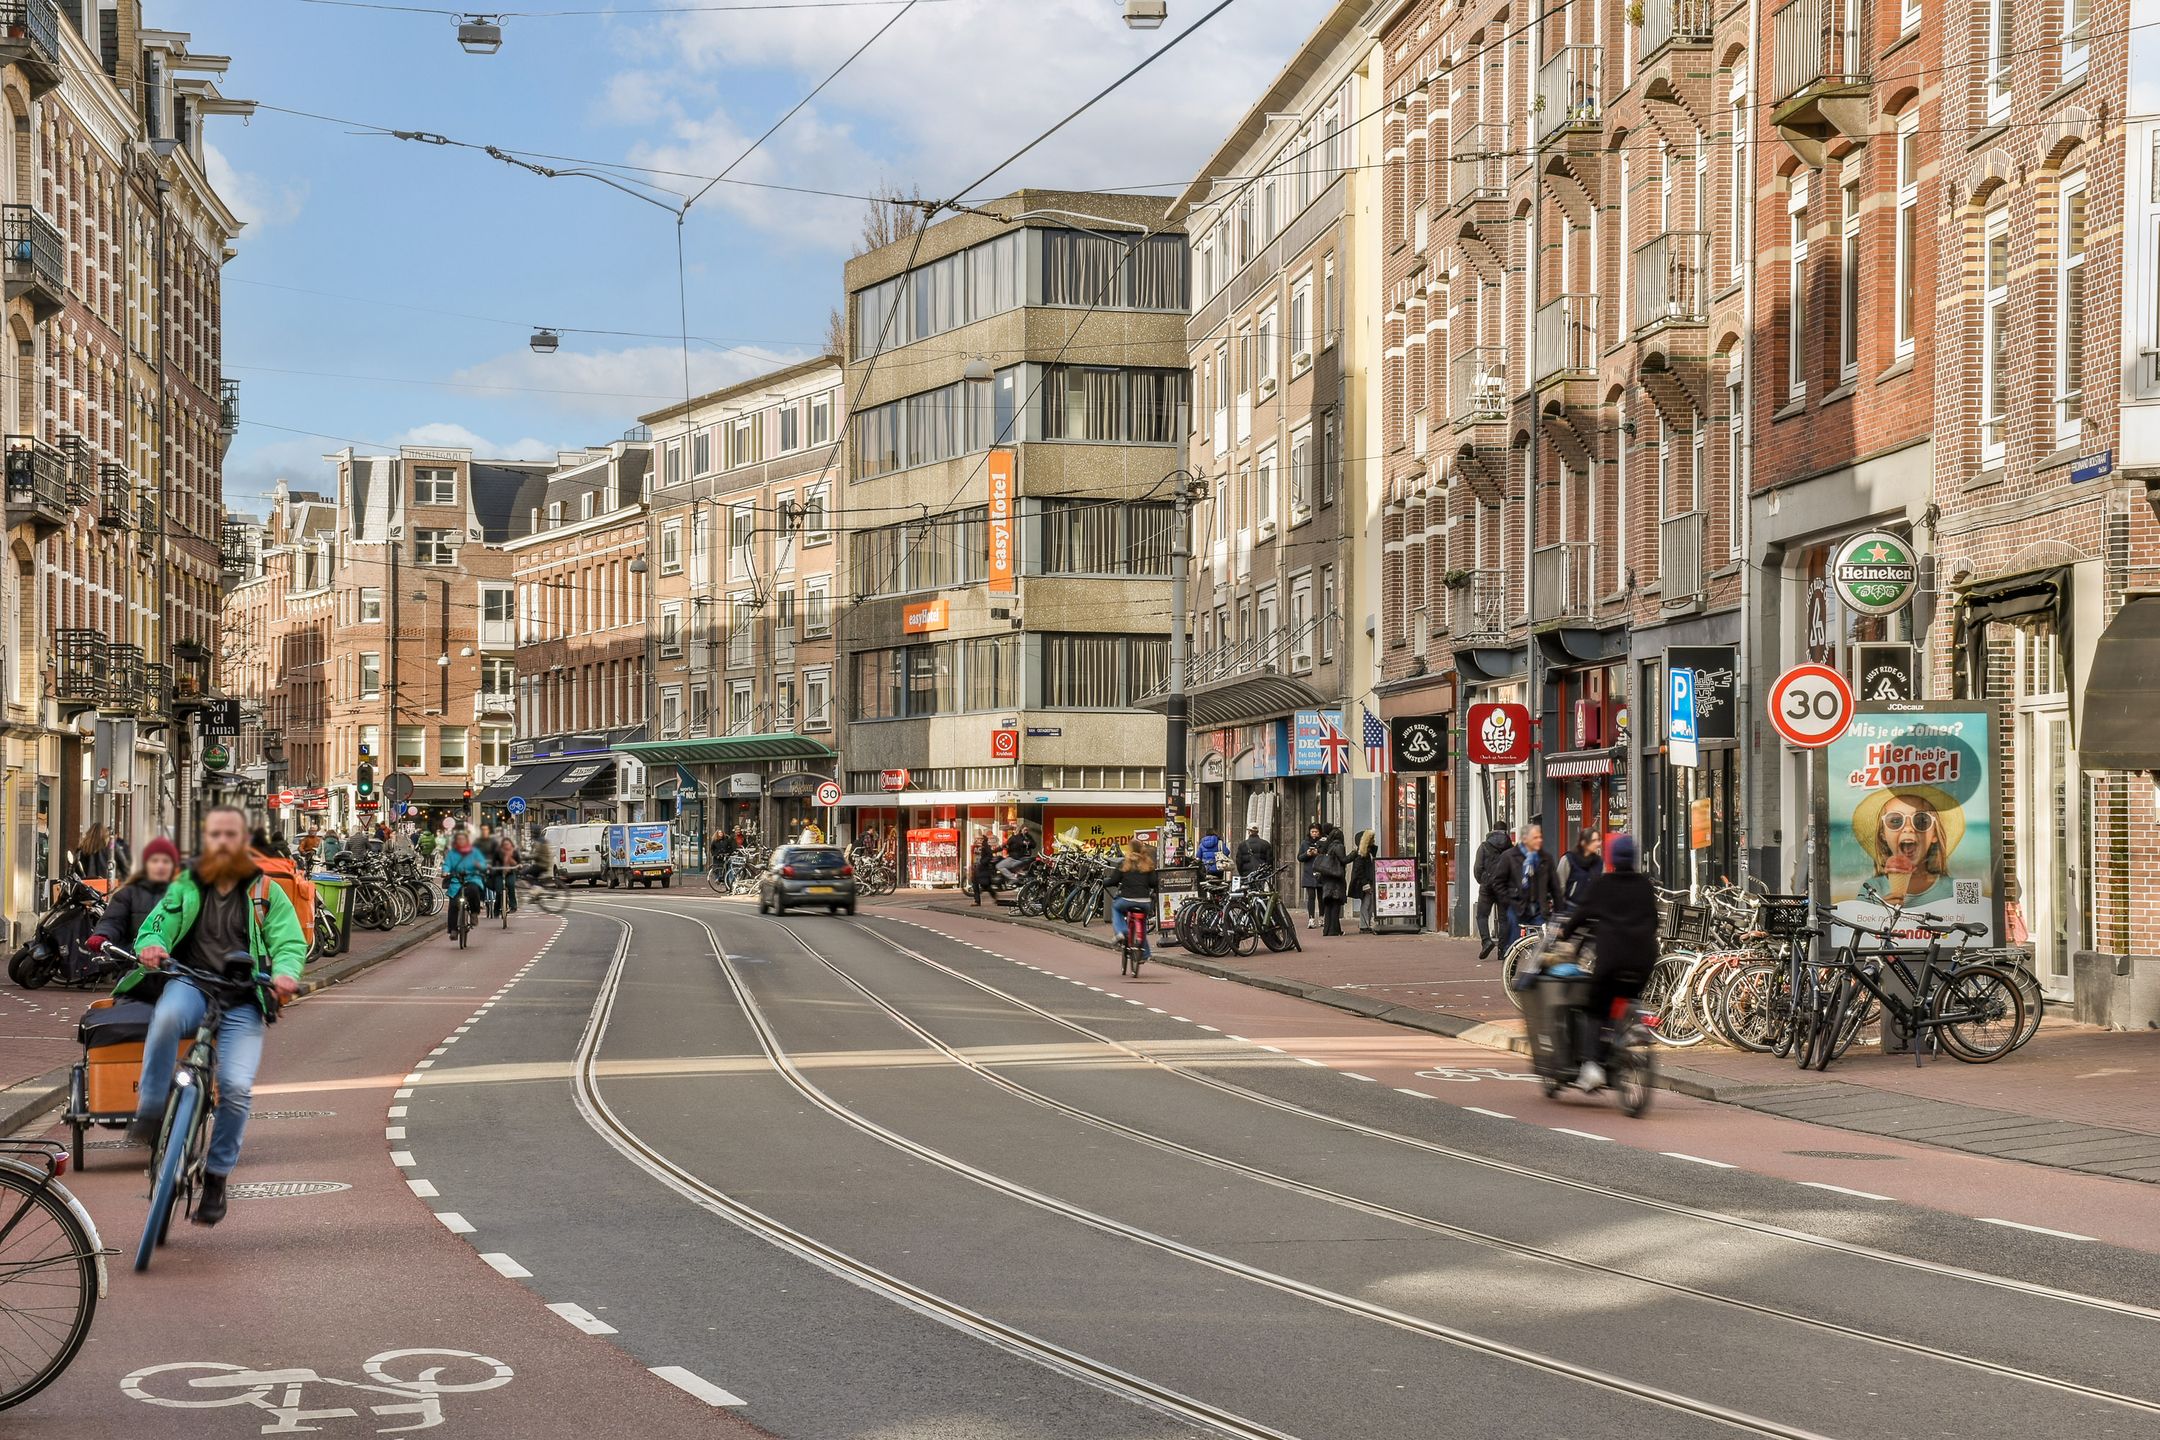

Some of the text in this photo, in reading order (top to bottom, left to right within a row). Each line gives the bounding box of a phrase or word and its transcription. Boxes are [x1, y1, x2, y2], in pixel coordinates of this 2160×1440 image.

[992, 473, 1009, 570] easyHotel
[1841, 566, 1912, 580] Heineken
[909, 608, 939, 627] easyHotel
[1865, 665, 1907, 683] JUST RIDE ON
[1674, 676, 1688, 711] P
[210, 701, 228, 712] Sol
[1786, 690, 1838, 720] 30
[1887, 703, 1924, 711] JCDecaux
[213, 713, 224, 724] el
[205, 724, 235, 735] Luna
[1402, 724, 1438, 739] JUST RIDE ON
[1847, 721, 1964, 739] Mis je de zomer?
[1402, 749, 1438, 763] AMSTERDAM
[1868, 744, 1946, 765] Hier heb je
[1850, 772, 1865, 784] de
[685, 791, 696, 799] NIX
[822, 789, 838, 799] 30
[1856, 914, 1876, 923] Boek
[1956, 914, 1966, 924] bij
